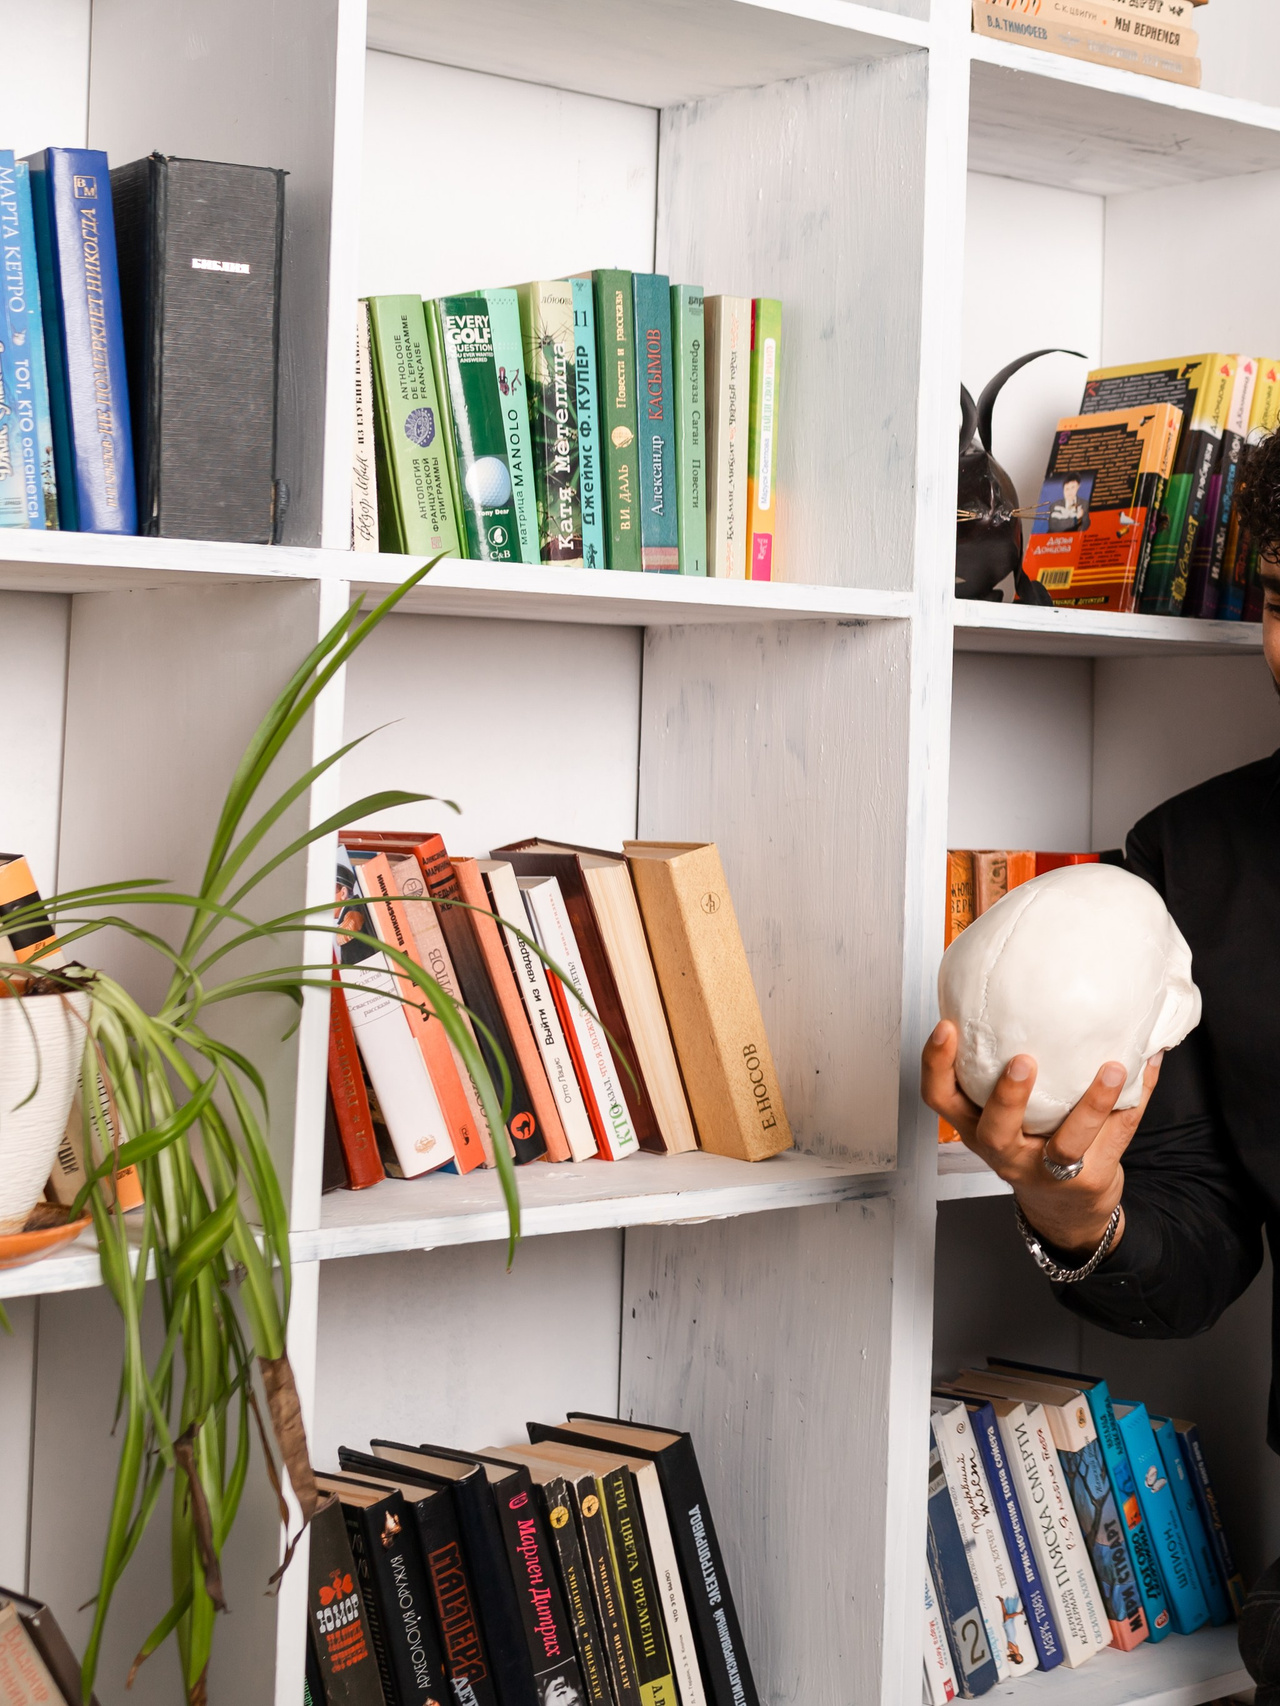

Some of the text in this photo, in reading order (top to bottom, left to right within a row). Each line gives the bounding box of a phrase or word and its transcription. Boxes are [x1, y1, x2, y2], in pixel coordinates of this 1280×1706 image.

[1133, 22, 1182, 46] ВЕРНЕМСЯ
[4, 245, 26, 313] КЕТРО
[80, 208, 103, 294] НИКОГДА
[191, 257, 250, 275] БИБЛИЯ
[446, 315, 489, 328] EVERY
[446, 328, 491, 344] GOLF
[574, 310, 588, 328] 11
[615, 290, 627, 341] рассказы
[87, 293, 110, 406] ПОМЕРКНЕТ
[394, 335, 409, 400] ANTHOLOGIE
[414, 342, 427, 399] FRANÇAISE
[412, 386, 419, 400] DE
[616, 361, 626, 408] Повести
[18, 400, 34, 433] КТО
[646, 329, 664, 517] Александр КАСЫМОВ
[690, 340, 701, 509] Франсуаза Саган Повести
[553, 342, 574, 550] Катя Метелица
[412, 459, 427, 519] АНТОЛОГИЯ
[424, 457, 439, 532] ФРАНЦУЗСКОЙ
[432, 457, 447, 520] ЭПИГРАММЫ
[508, 409, 528, 545] матрица MANOLO
[580, 444, 595, 526] Джеймс
[618, 464, 632, 503] ДАЛЬ
[761, 477, 770, 503] Маруся
[374, 873, 406, 946] ВЕЛИКОБРИАНИИ
[530, 987, 543, 1003] из
[534, 1007, 556, 1046] Выйти
[581, 1009, 602, 1051] ДОЛЖНА
[551, 1056, 568, 1083] Лацис
[559, 1082, 573, 1104] Отто
[596, 1058, 609, 1077] ЧТО
[607, 1101, 634, 1147] КТО
[1014, 1421, 1071, 1589] ПЛЯСКА СМЕРТИ
[613, 1476, 656, 1658] ТРИ ЦВЕТА ВРЕМЕНИ
[687, 1504, 721, 1606] ЭЛЕКТРОПРИВОД
[985, 1528, 1007, 1589] ТЕРИ ХЭТЧЕР
[1105, 1518, 1130, 1586] СТЮАРТ
[1163, 1522, 1189, 1590] ШПИОН,
[315, 1592, 361, 1634] ЮМОР
[517, 1518, 560, 1658] Марлен Дитрих
[567, 1566, 586, 1628] ПОЛИТИКА
[598, 1556, 616, 1617] ПОЛИТИКА
[668, 1592, 677, 1608] ЭТО
[1058, 1591, 1079, 1638] БЕРНГАРД
[1076, 1569, 1104, 1644] СЕСИЛИЯ АХЕРН
[390, 1554, 431, 1689] АРХЕОЛОГИЯ ОРУЖИЯ
[961, 1618, 985, 1665] 2
[1064, 1588, 1089, 1645] КЕЛЛЕРМАН
[582, 1640, 603, 1699] ДЕТЕКТИВ
[612, 1632, 631, 1689] ДЕТЕКТИВ
